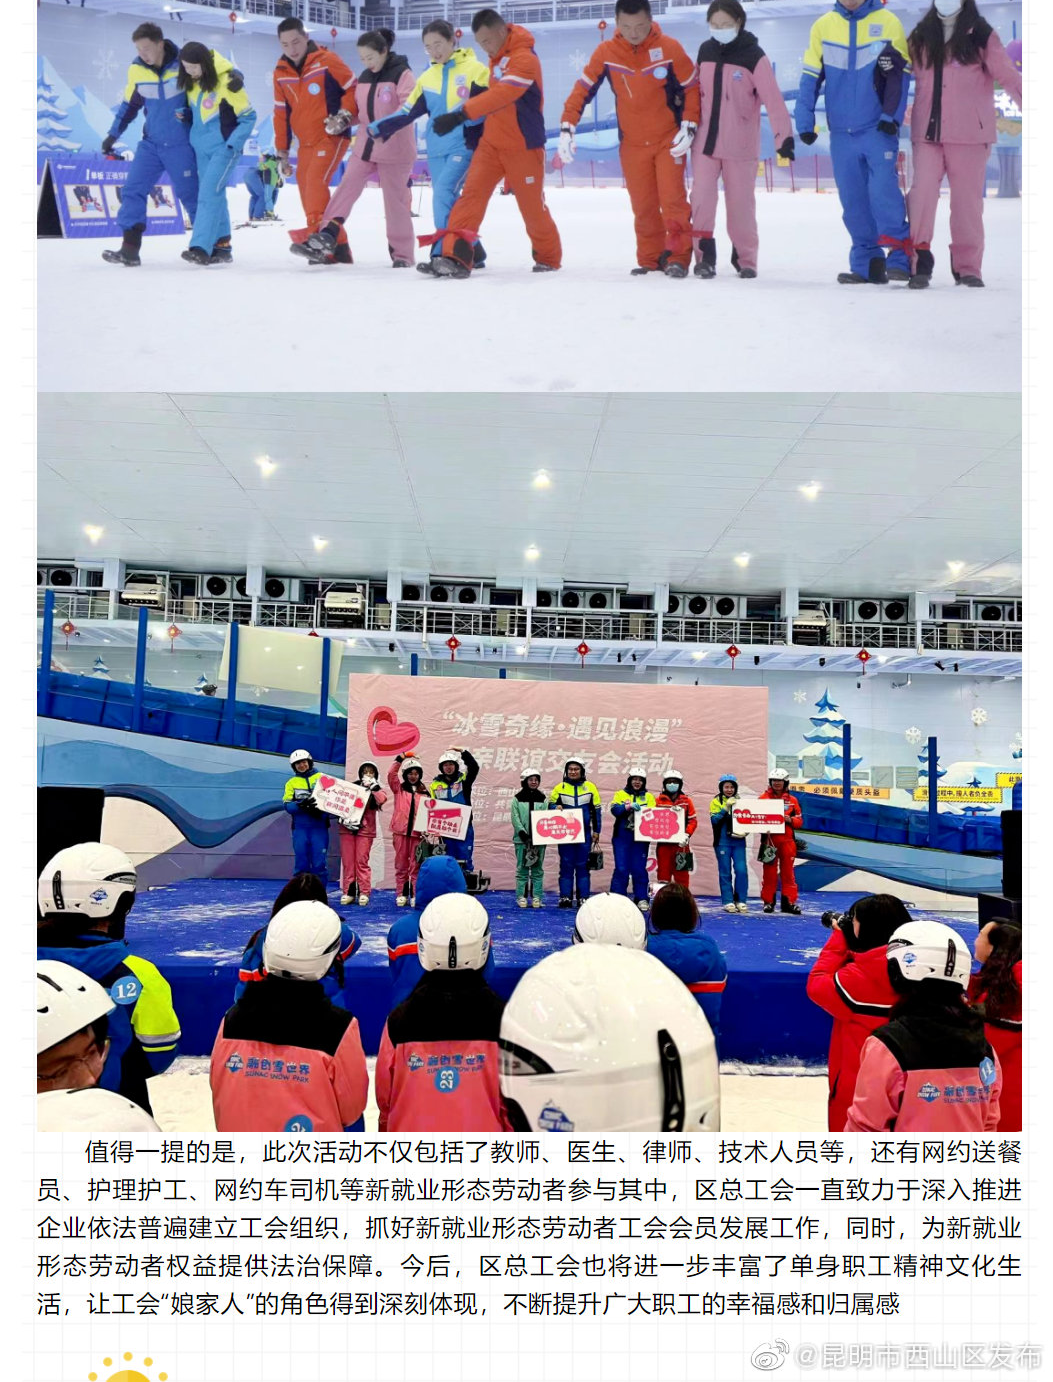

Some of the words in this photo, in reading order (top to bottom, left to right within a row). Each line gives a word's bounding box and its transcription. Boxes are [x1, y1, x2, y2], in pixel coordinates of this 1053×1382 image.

[442, 710, 683, 743] “冰雪奇缘·遇见浪漫”
[116, 982, 137, 999] 12
[246, 1057, 310, 1075] 融创雪世界
[440, 1069, 454, 1089] 23
